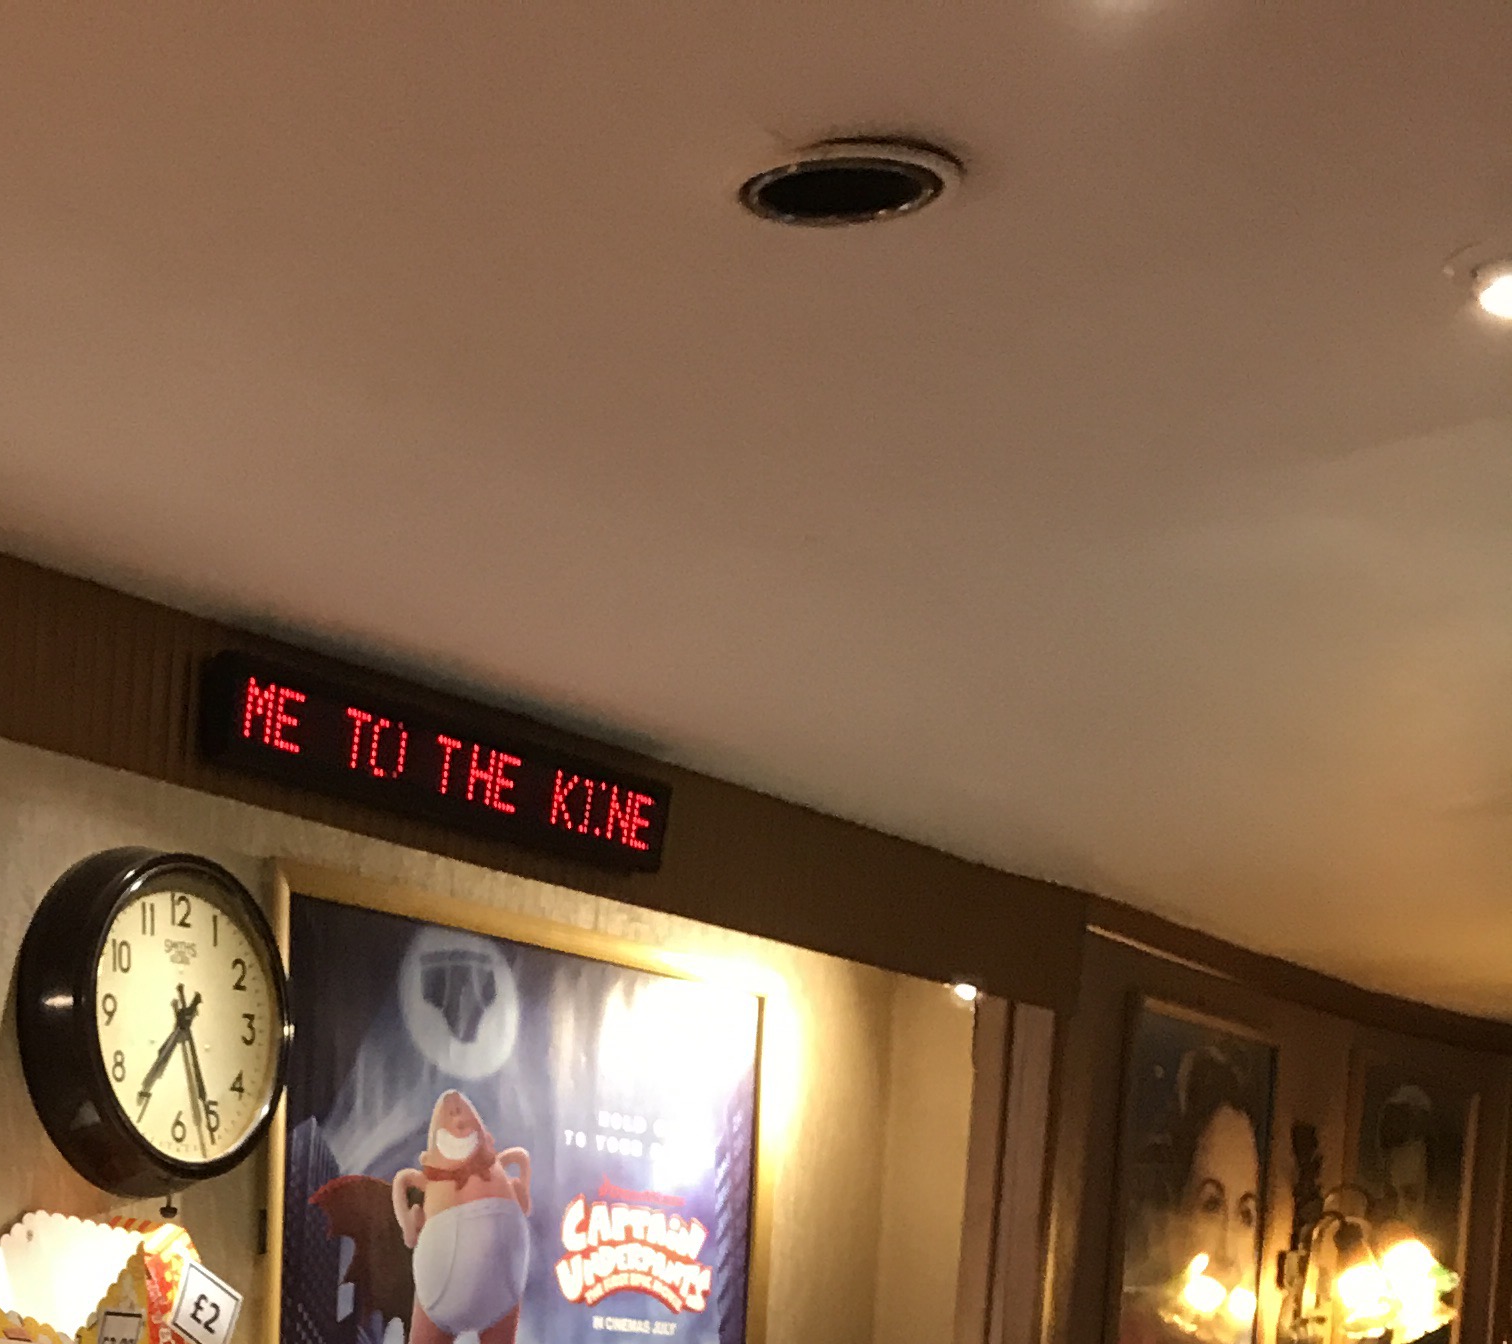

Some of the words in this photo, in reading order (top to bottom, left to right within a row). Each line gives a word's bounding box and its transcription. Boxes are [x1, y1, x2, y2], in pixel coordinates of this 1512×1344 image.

[243, 677, 306, 753] ME
[347, 706, 408, 778] TO
[438, 734, 522, 814] THE
[141, 902, 155, 936] 11
[171, 892, 192, 928] 12
[112, 938, 132, 973] 10
[231, 958, 247, 992] 2
[102, 993, 118, 1027] 9
[241, 1013, 256, 1046] 3
[112, 1050, 126, 1083] 8
[229, 1069, 245, 1100] 4
[171, 1111, 187, 1144] 6
[205, 1100, 220, 1133] 5
[189, 1293, 220, 1335] £2
